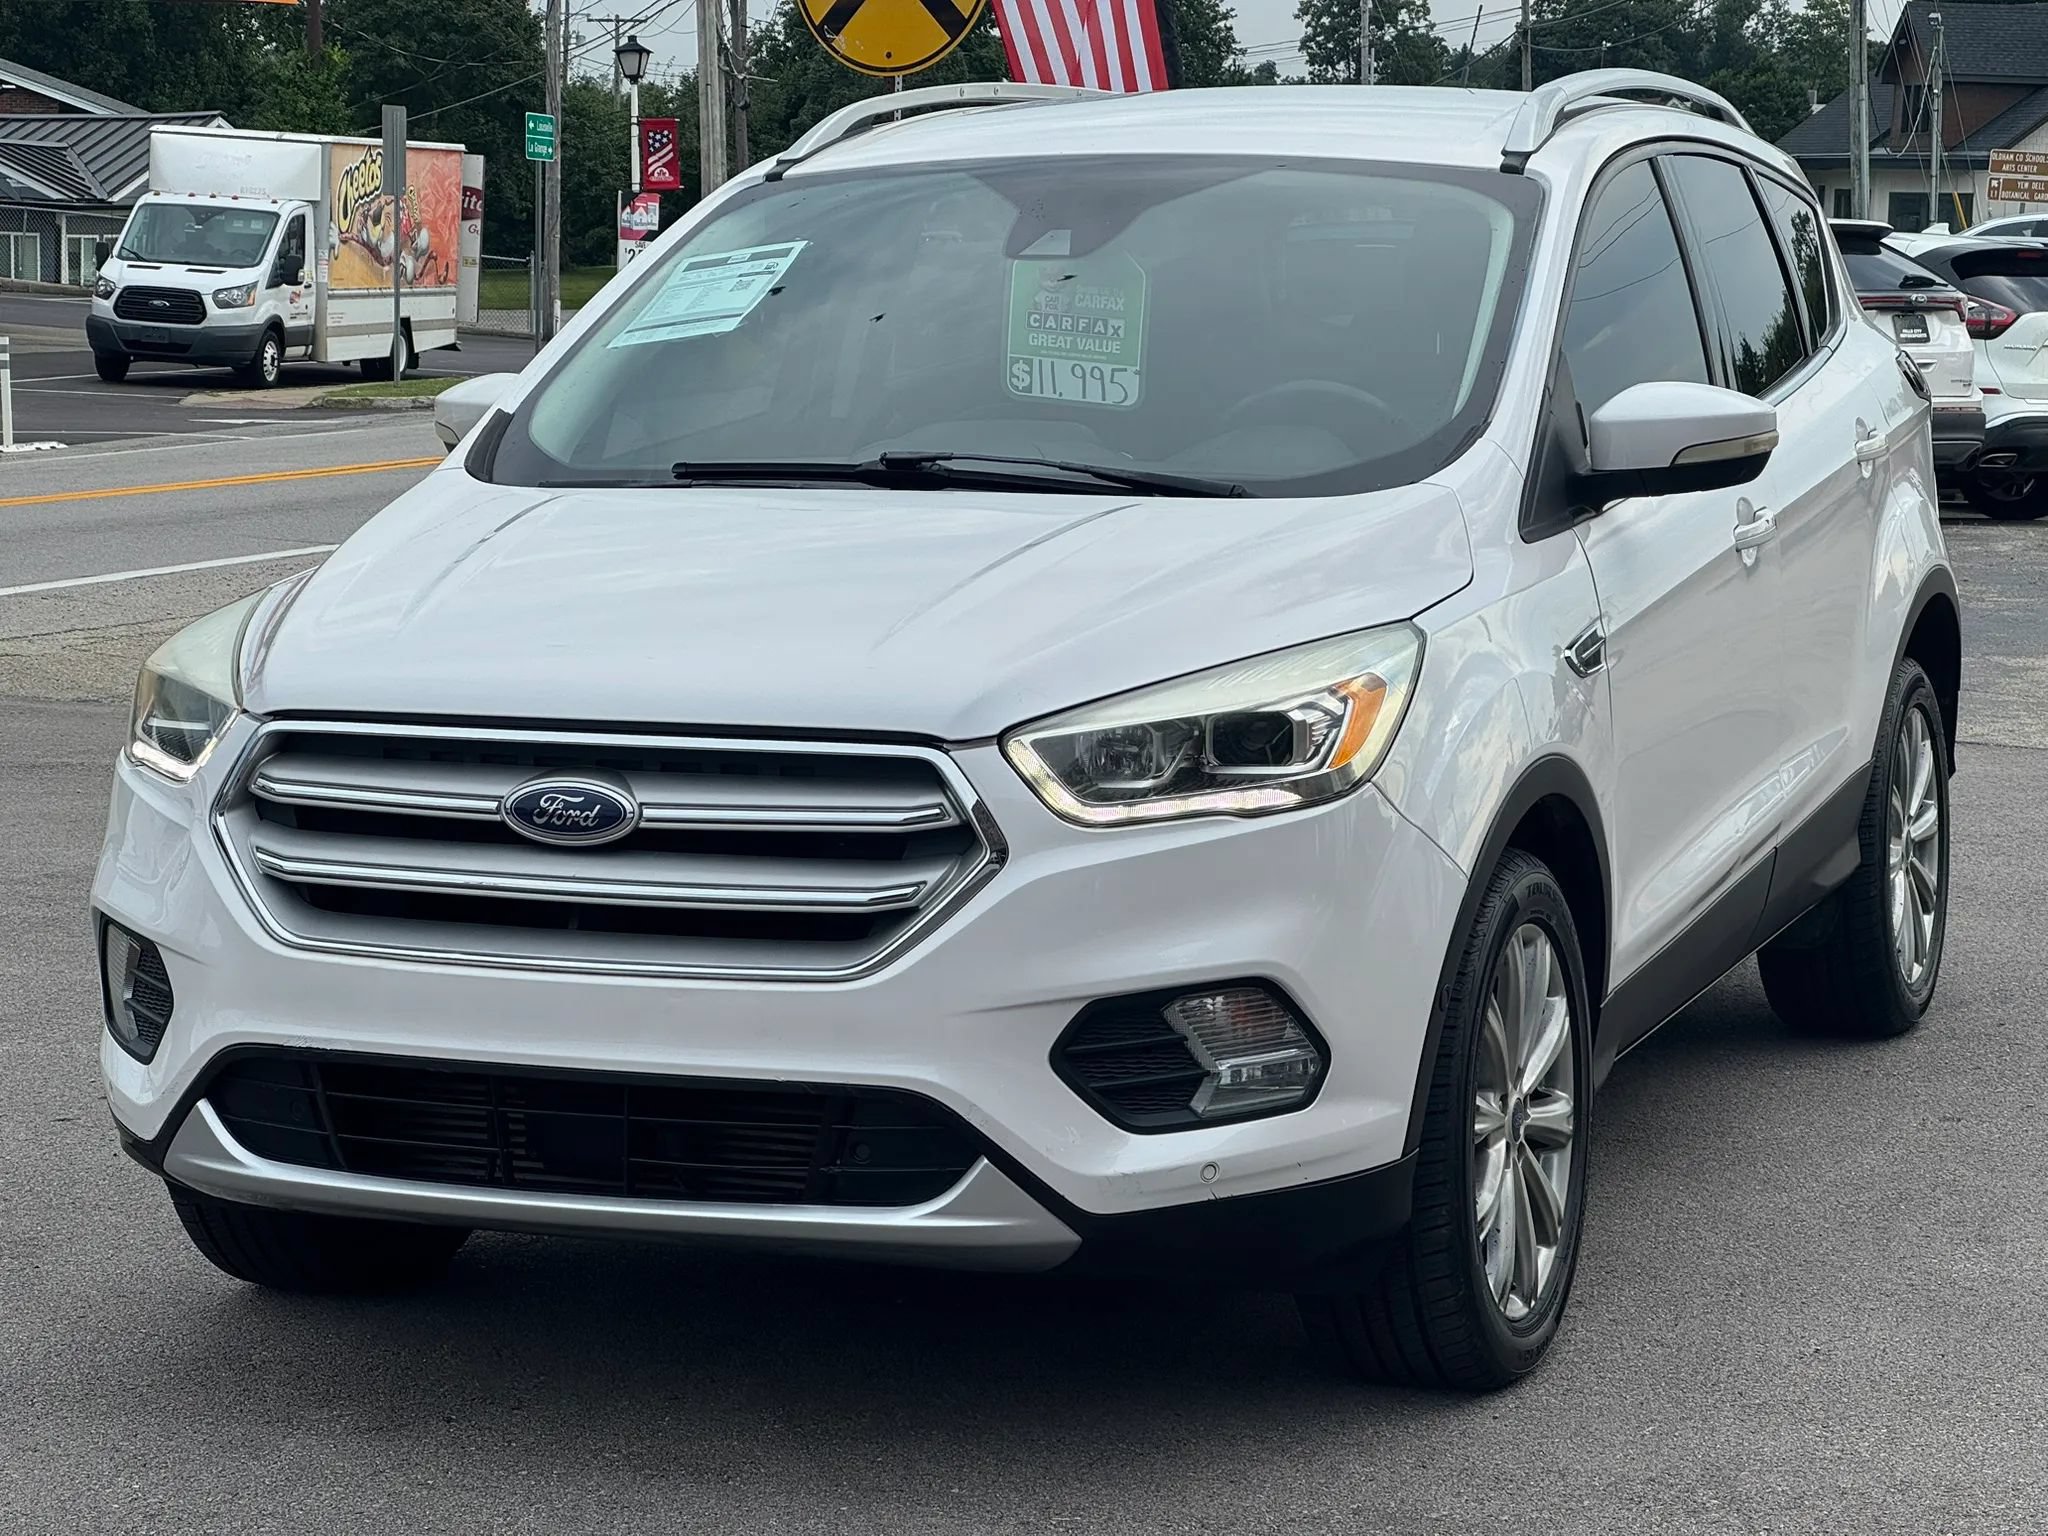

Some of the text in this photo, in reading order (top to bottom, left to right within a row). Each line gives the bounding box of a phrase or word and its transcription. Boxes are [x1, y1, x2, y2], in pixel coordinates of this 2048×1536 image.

[1992, 152, 2014, 161] OLDHAM
[2016, 153, 2023, 161] CO
[2002, 163, 2037, 172] ARTS CENTER
[337, 145, 383, 235] Cheetos
[2017, 181, 2044, 190] YEW DELL
[2001, 190, 2030, 200] BOTANICAL
[1074, 294, 1124, 312] CARFAX
[1027, 312, 1125, 338] CARFAX
[1028, 333, 1121, 354] GREAT VALUE
[532, 793, 602, 827] Ford
